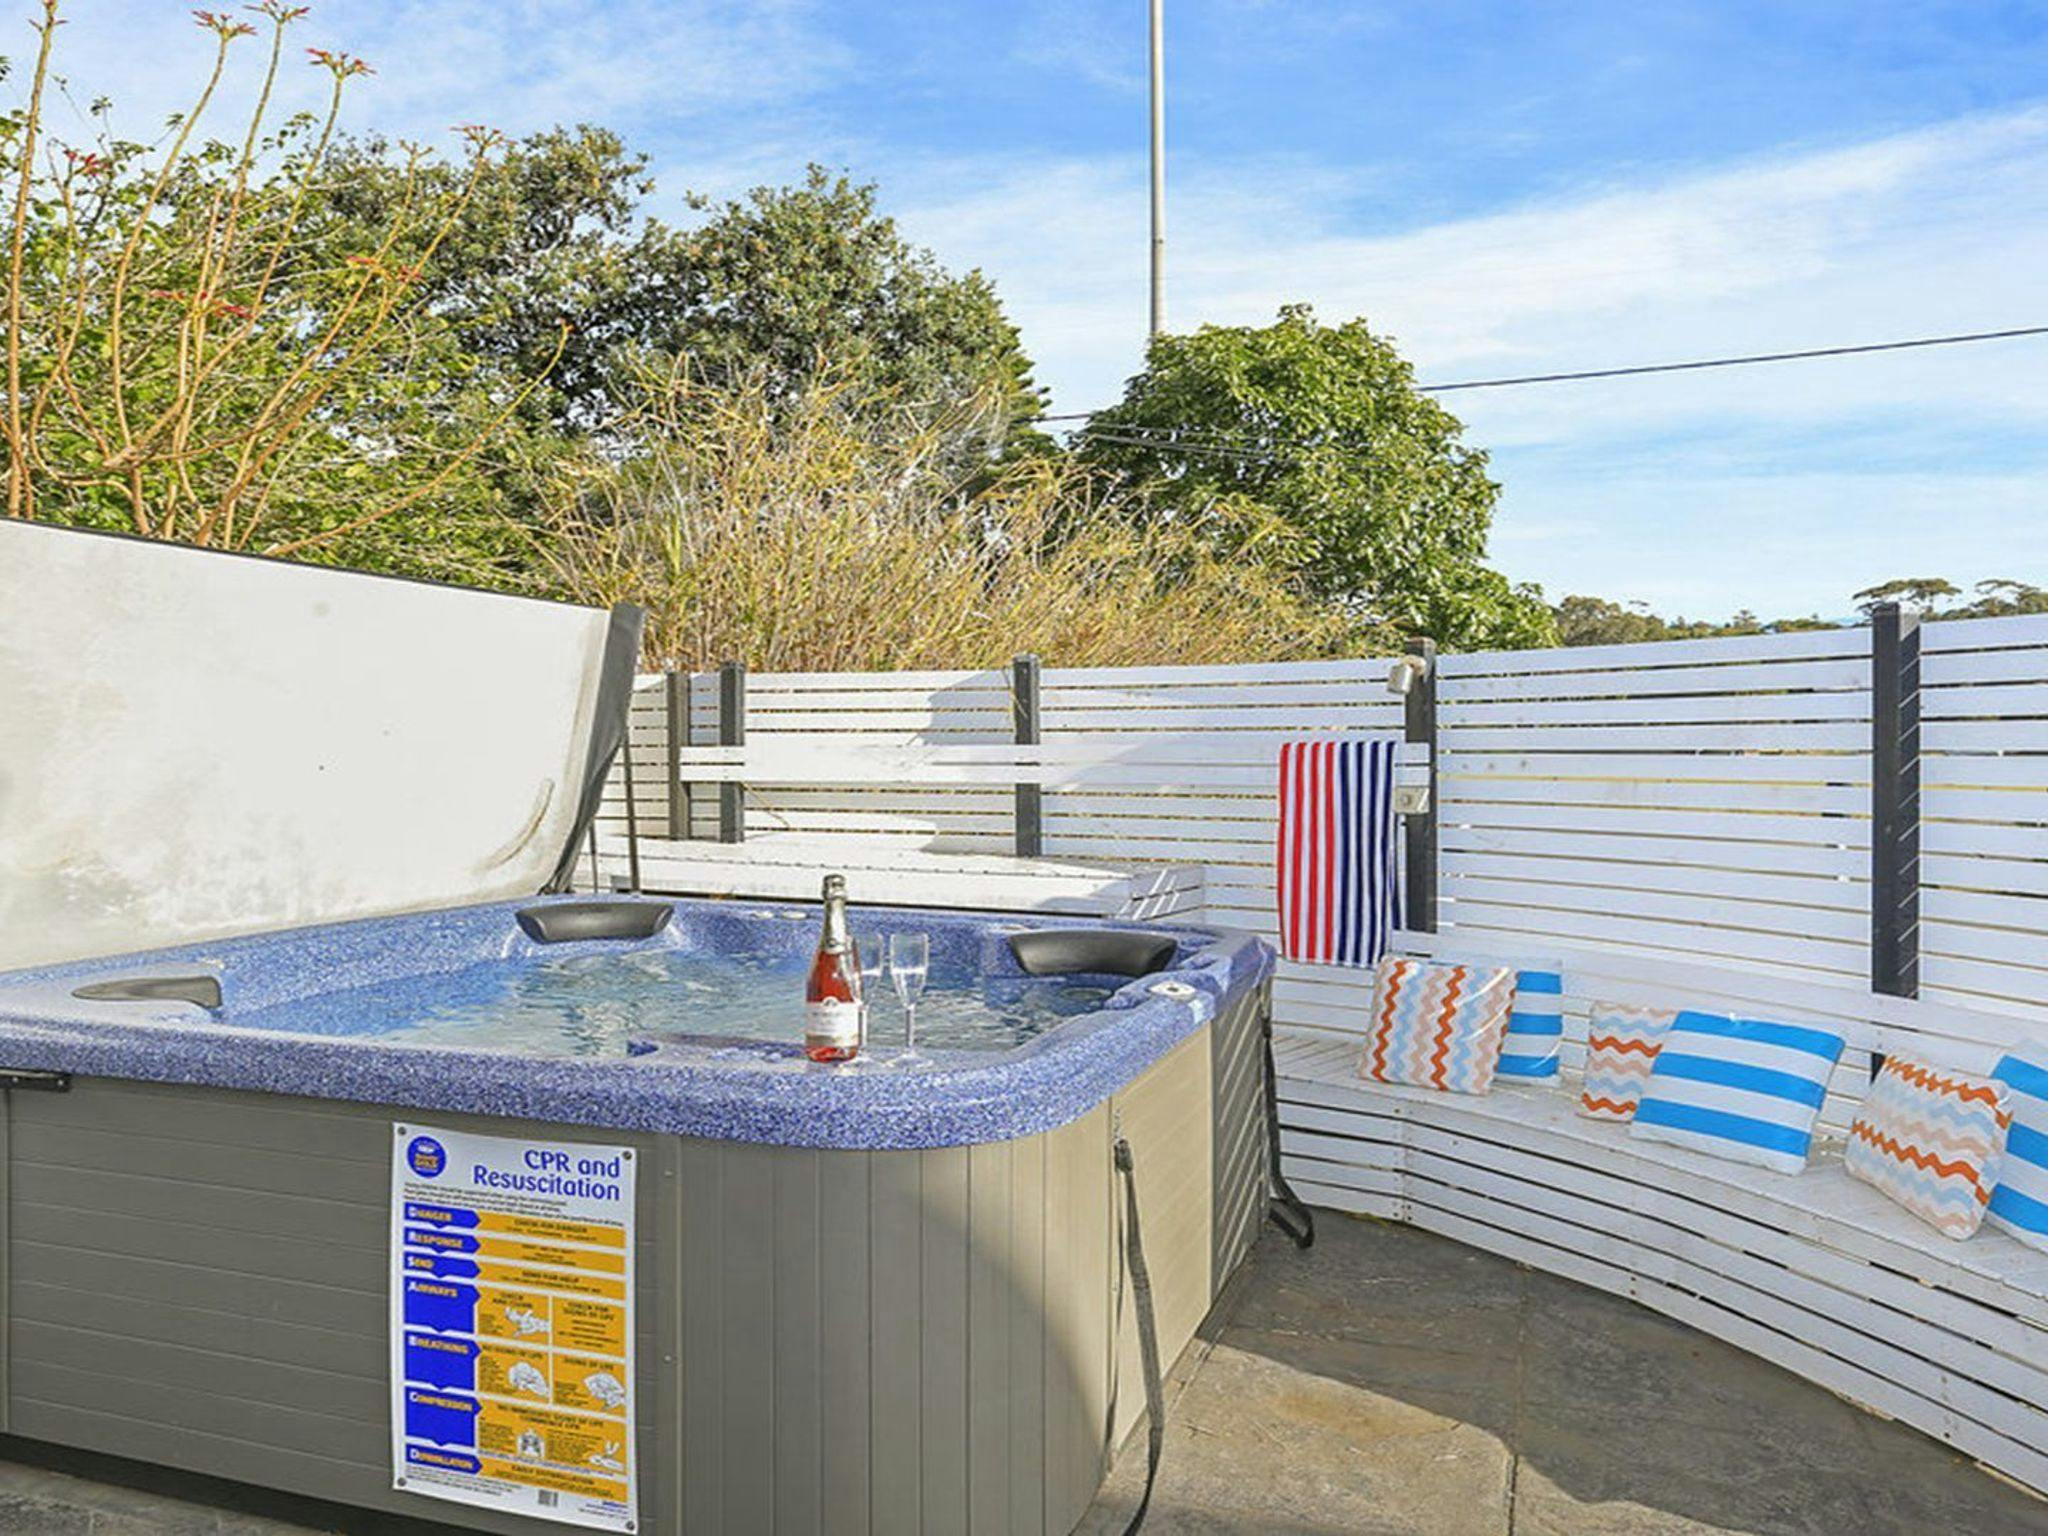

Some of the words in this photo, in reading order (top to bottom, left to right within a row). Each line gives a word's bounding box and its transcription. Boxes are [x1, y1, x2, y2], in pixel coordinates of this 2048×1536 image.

[525, 1150, 570, 1173] CPR
[577, 1156, 620, 1178] and
[473, 1165, 620, 1200] Resuscitation
